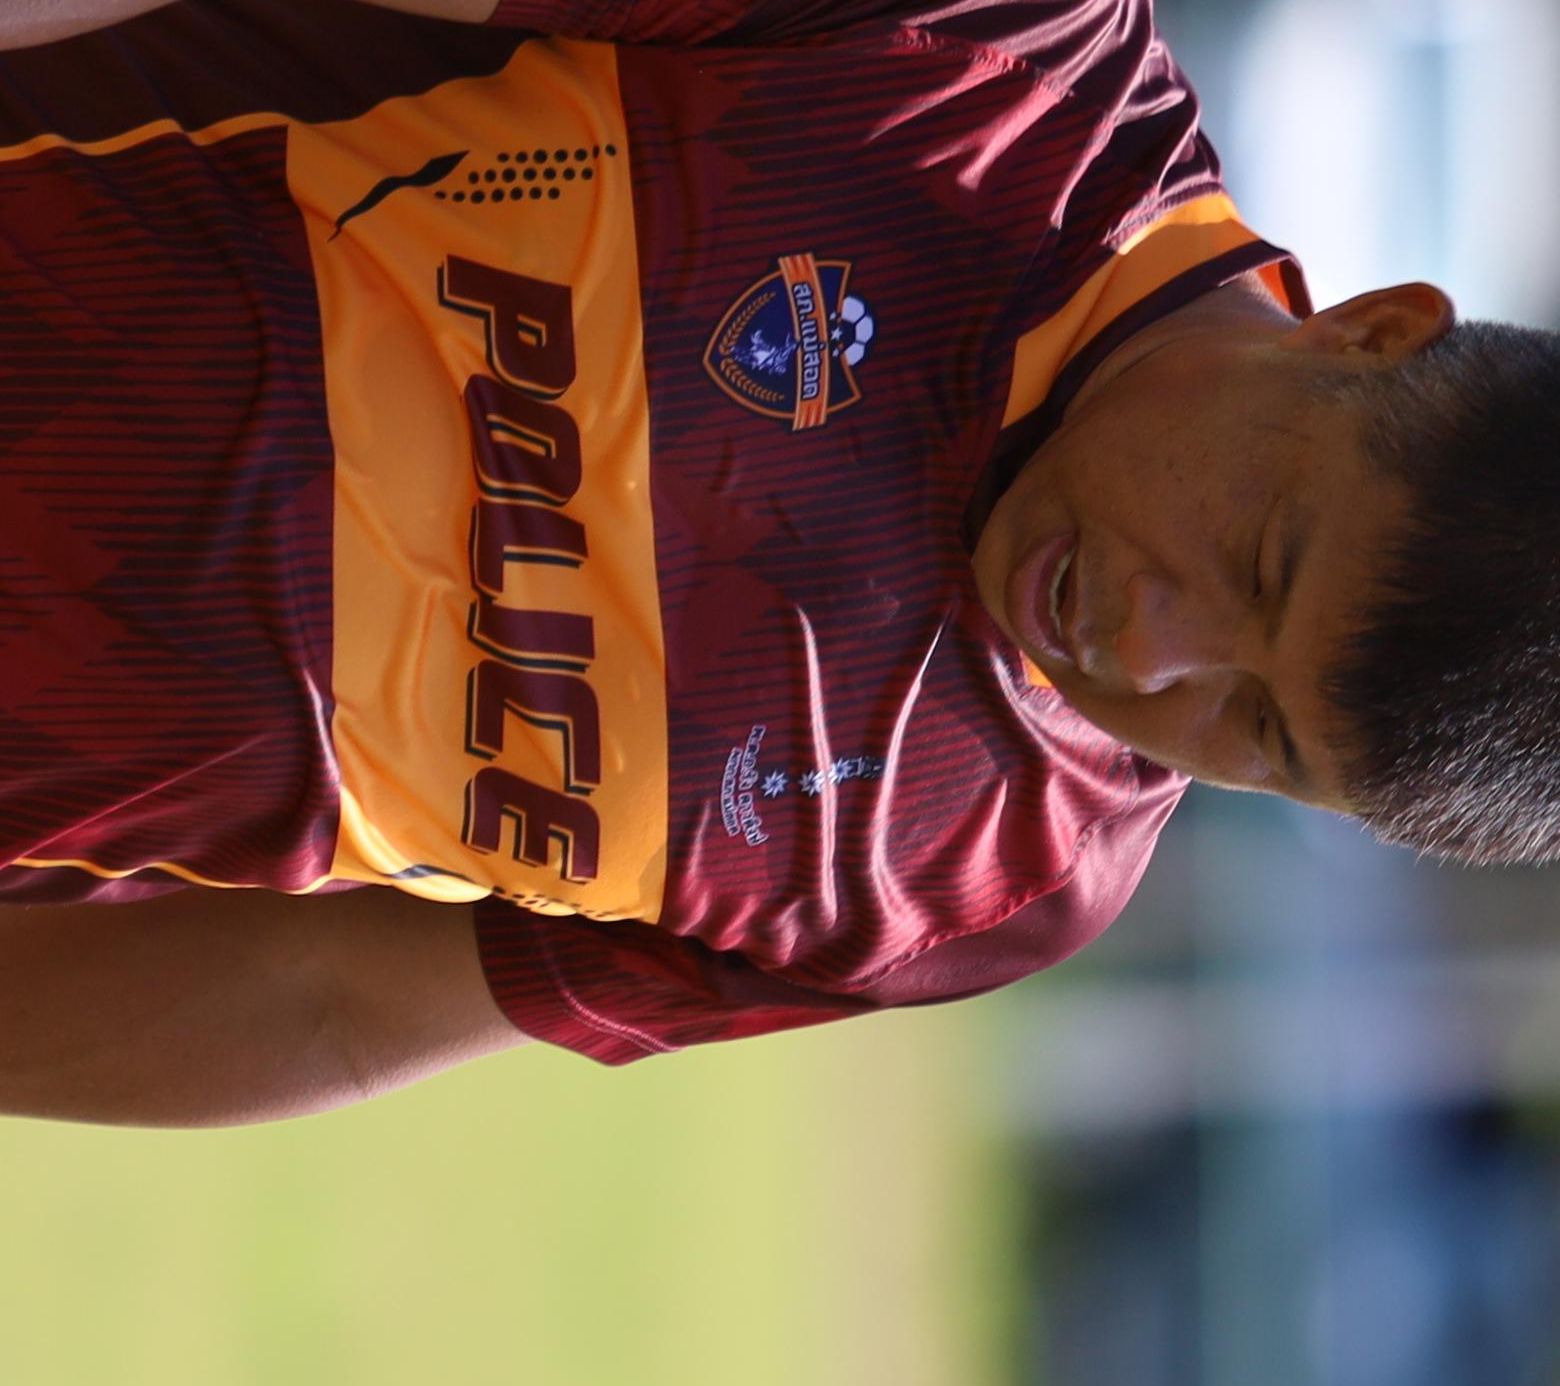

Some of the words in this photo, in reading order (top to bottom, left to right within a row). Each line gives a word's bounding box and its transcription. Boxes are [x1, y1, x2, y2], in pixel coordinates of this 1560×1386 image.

[792, 282, 826, 400] สภ.แม่สอด
[437, 254, 602, 886] POLICE
